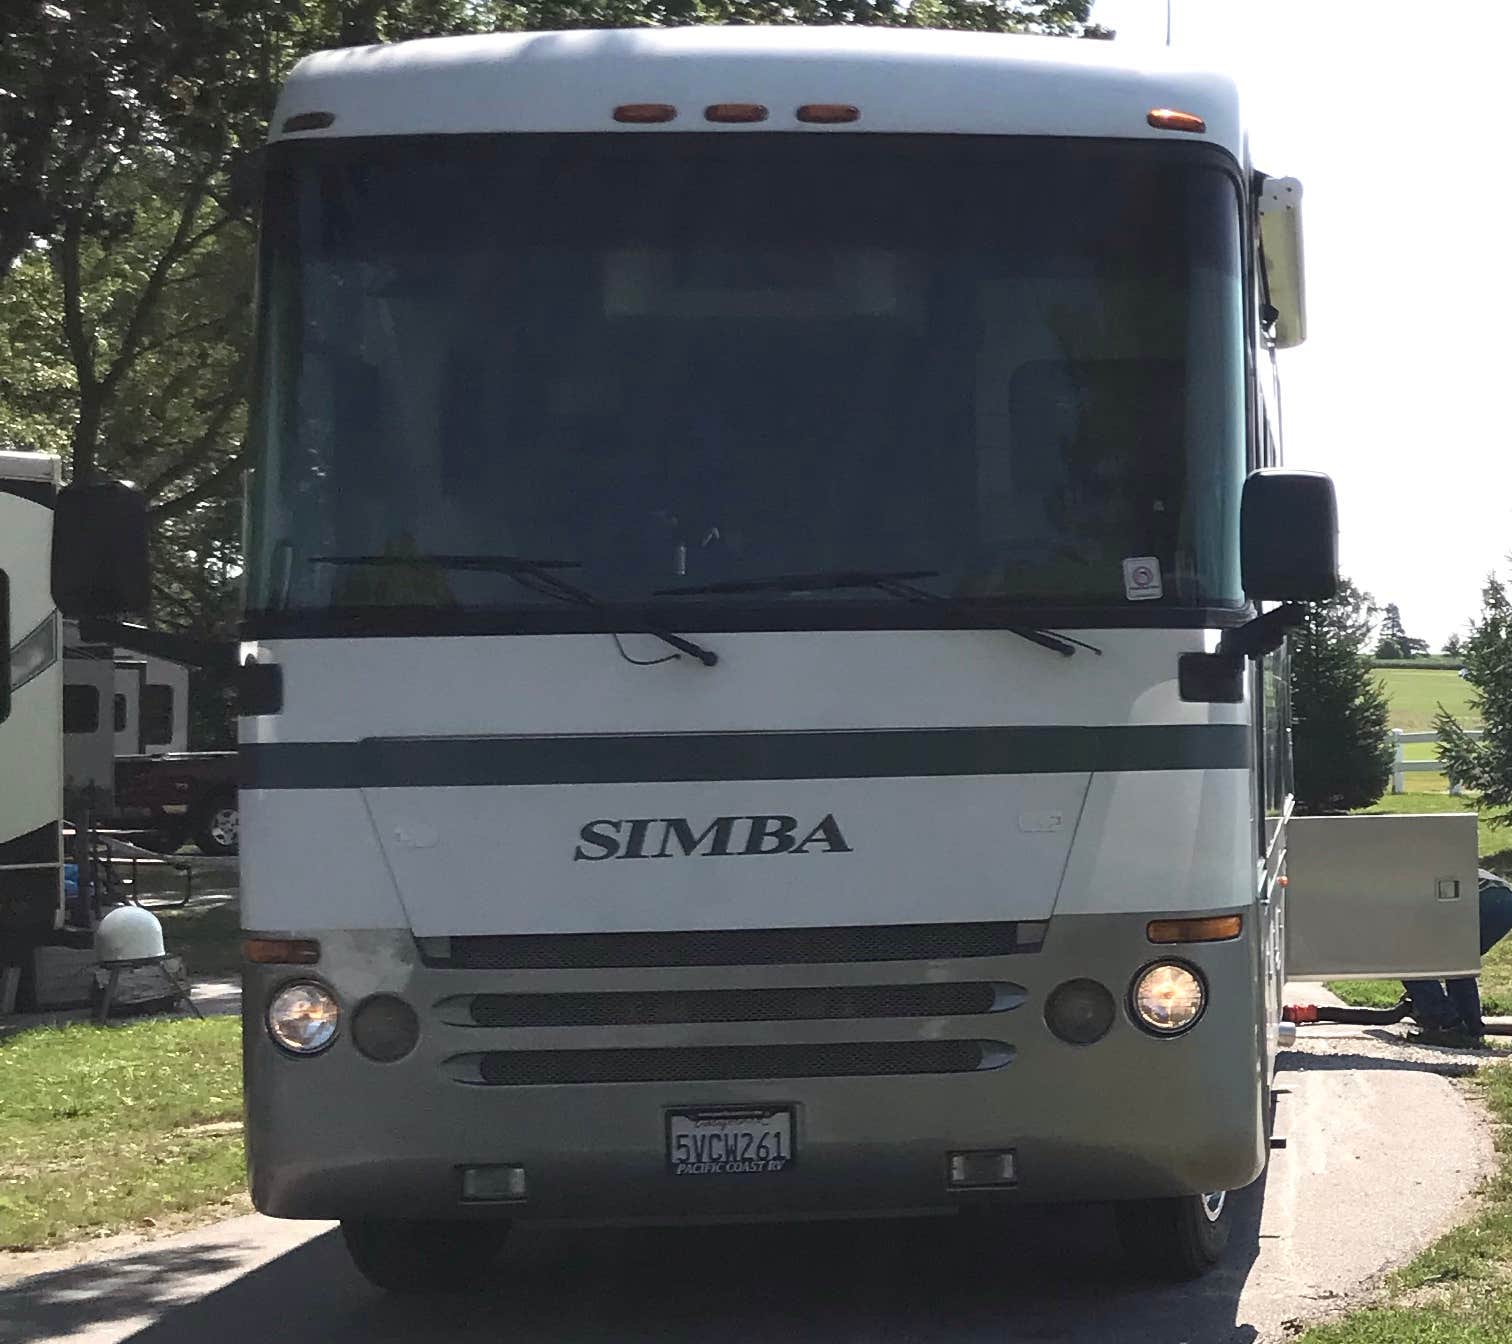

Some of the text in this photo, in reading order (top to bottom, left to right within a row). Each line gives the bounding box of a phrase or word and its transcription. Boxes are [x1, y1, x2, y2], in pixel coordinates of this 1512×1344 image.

[573, 813, 854, 862] SIMBA
[674, 1132, 787, 1162] 5VCW261
[676, 1159, 786, 1175] PACIFIC COAST RV
